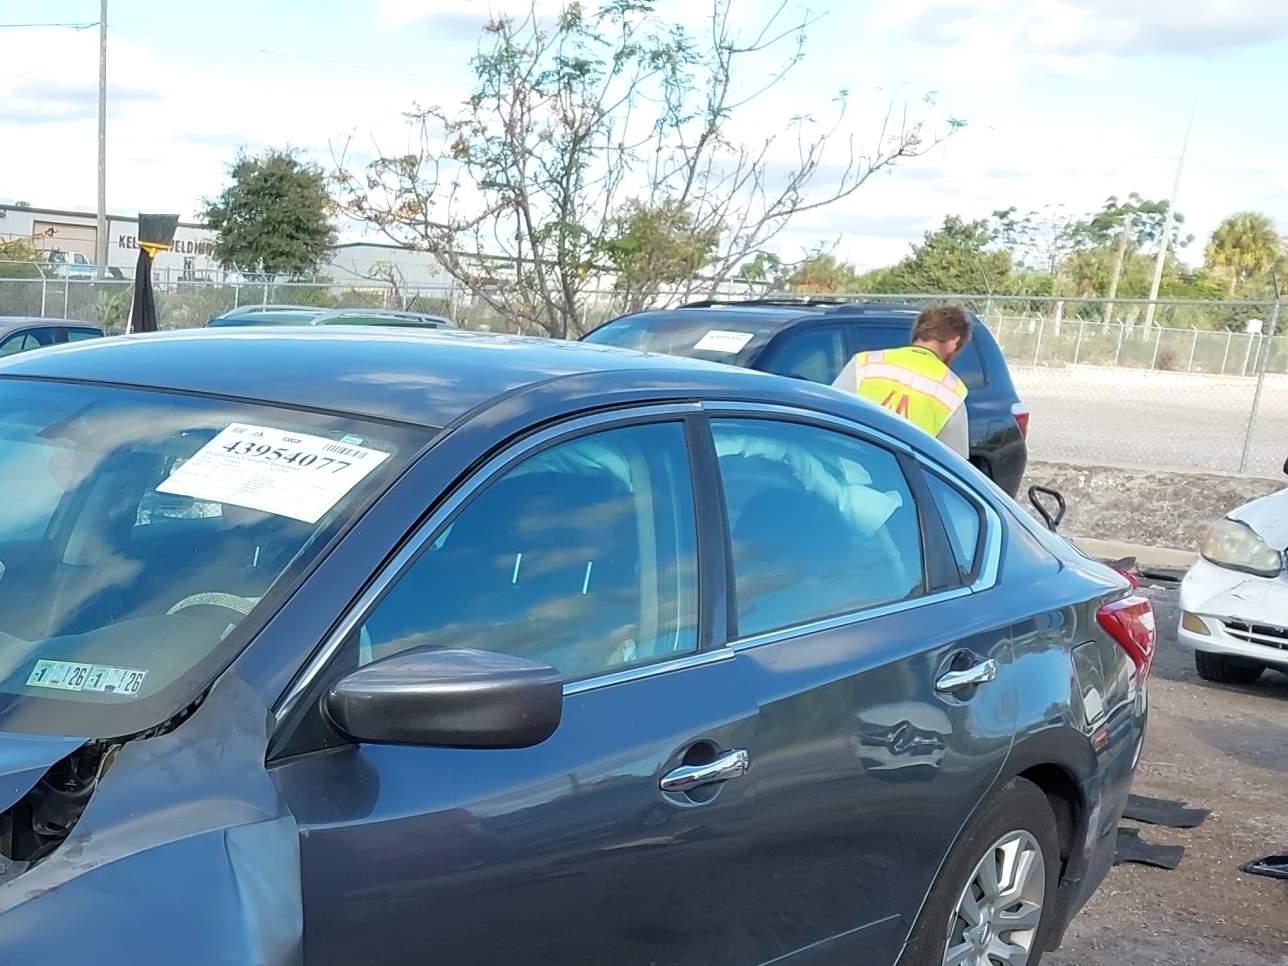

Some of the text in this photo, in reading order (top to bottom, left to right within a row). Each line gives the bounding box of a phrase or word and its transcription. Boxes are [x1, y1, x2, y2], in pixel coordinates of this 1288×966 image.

[222, 439, 352, 474] 43954077
[68, 666, 87, 686] 26
[125, 672, 143, 693] 26
